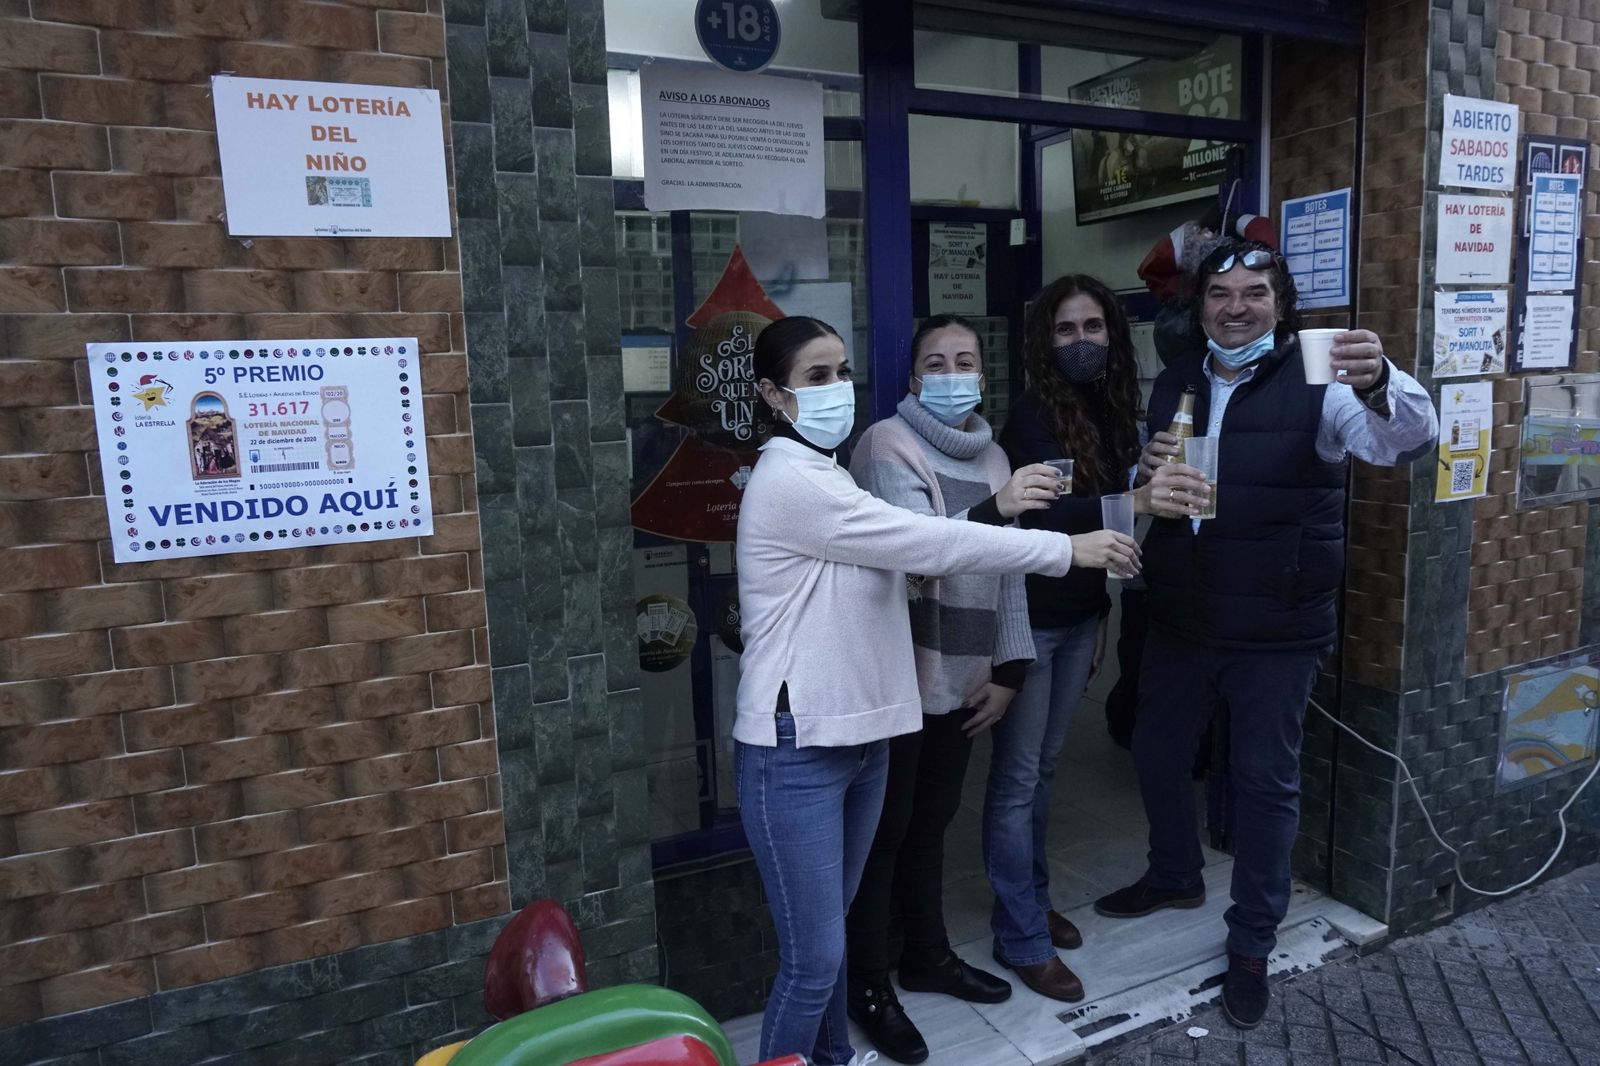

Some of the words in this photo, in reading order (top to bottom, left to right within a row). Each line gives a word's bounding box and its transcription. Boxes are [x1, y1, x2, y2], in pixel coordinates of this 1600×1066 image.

[706, 2, 761, 41] +18
[1178, 63, 1233, 106] BOTE
[246, 92, 299, 111] HAY
[308, 95, 412, 117] LOTERÍA
[659, 90, 688, 101] AVISO
[690, 93, 698, 102] A
[699, 94, 717, 103] LOS
[719, 95, 770, 108] ABONADOS
[1452, 108, 1512, 132] ABIERTO
[310, 124, 358, 143] DEL
[1450, 138, 1509, 158] SABADOS
[305, 151, 367, 172] NIÑO
[1457, 163, 1504, 183] TARDES
[1304, 199, 1328, 213] BOTES
[1445, 203, 1466, 215] HAY
[1468, 203, 1506, 217] LOTERÍA
[1469, 223, 1482, 234] DE
[1454, 241, 1495, 253] NAVIDAD
[942, 292, 974, 300] NAVIDAD
[1458, 326, 1478, 338] SORT
[1479, 326, 1485, 337] Y
[204, 366, 226, 385] 5º
[233, 363, 324, 384] PREMIO
[719, 382, 750, 401] QUE
[248, 400, 310, 417] 31.617
[243, 421, 278, 429] LOTERÍA
[280, 419, 320, 428] NACIONAL
[271, 428, 307, 437] NAVIDAD
[267, 437, 294, 445] diciembre
[148, 495, 309, 527] VENDIDO
[318, 481, 400, 517] AQUÍ
